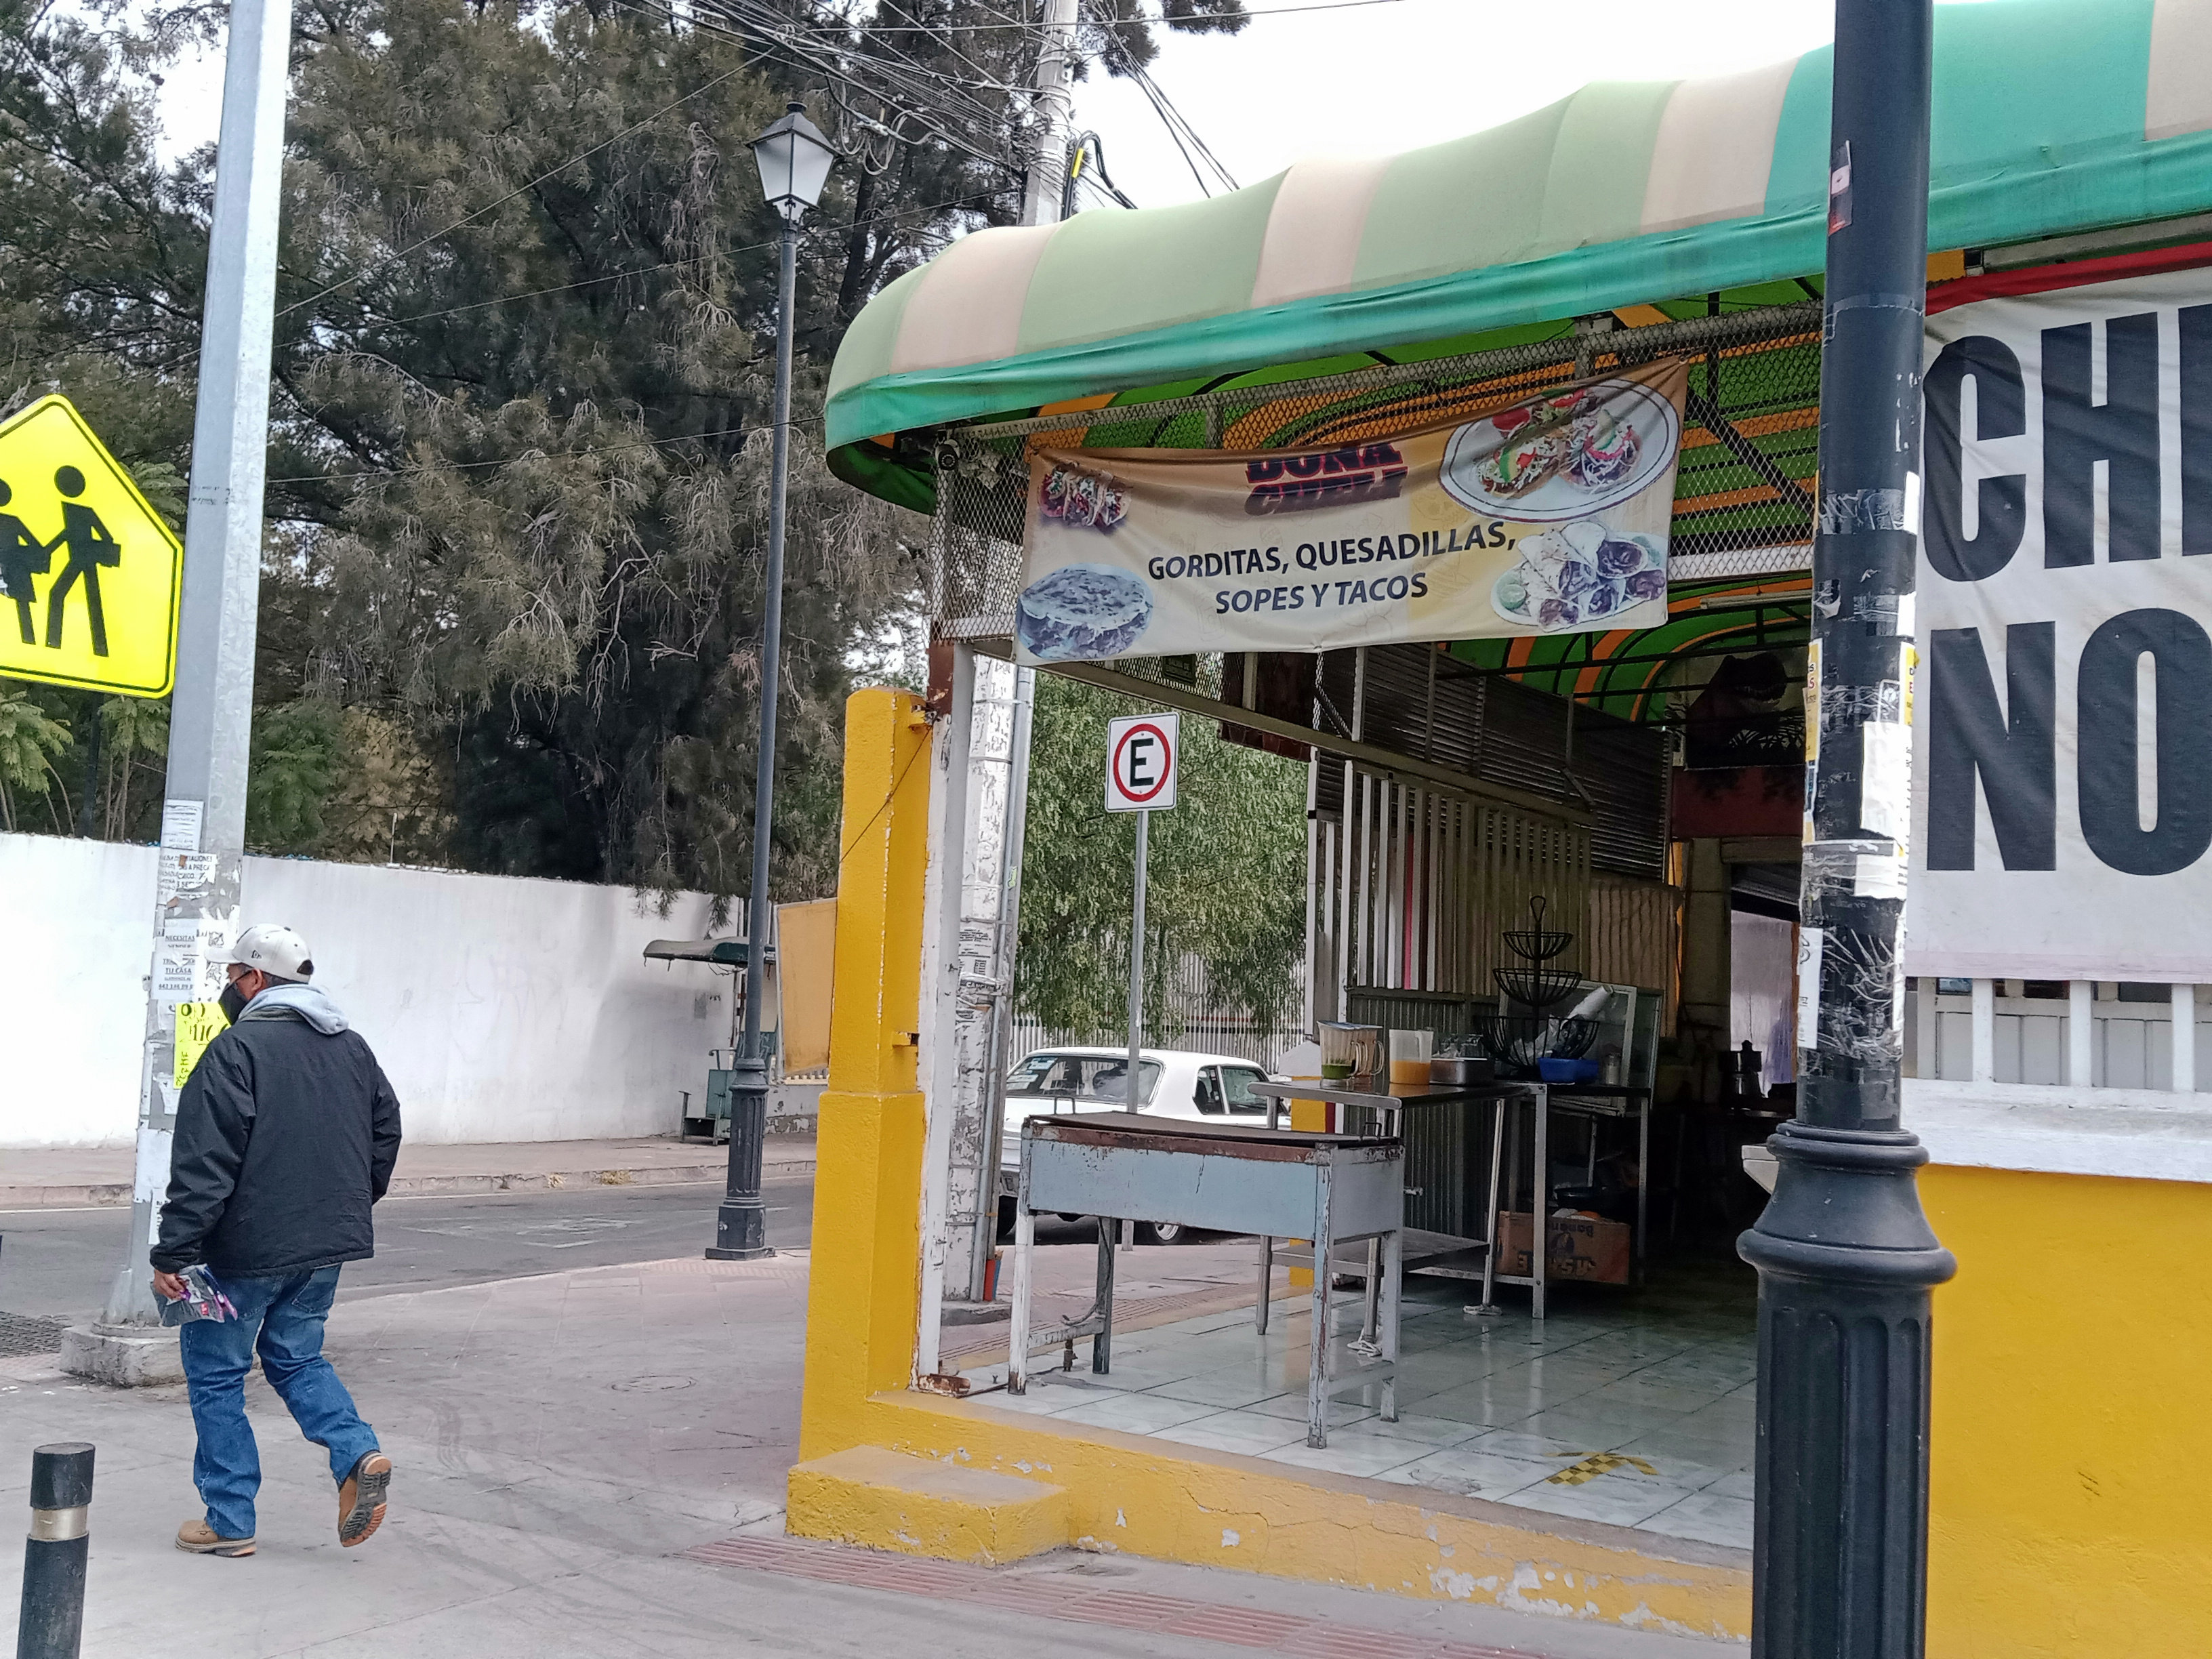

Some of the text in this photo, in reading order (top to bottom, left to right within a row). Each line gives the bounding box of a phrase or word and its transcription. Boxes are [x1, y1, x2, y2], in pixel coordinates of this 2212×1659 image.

[1148, 520, 1515, 580] GORDITAS, QUESADILLAS,
[1216, 571, 1429, 614] SOPES Y TACOS
[1130, 737, 1154, 787] E
[1926, 607, 2212, 876] NO
